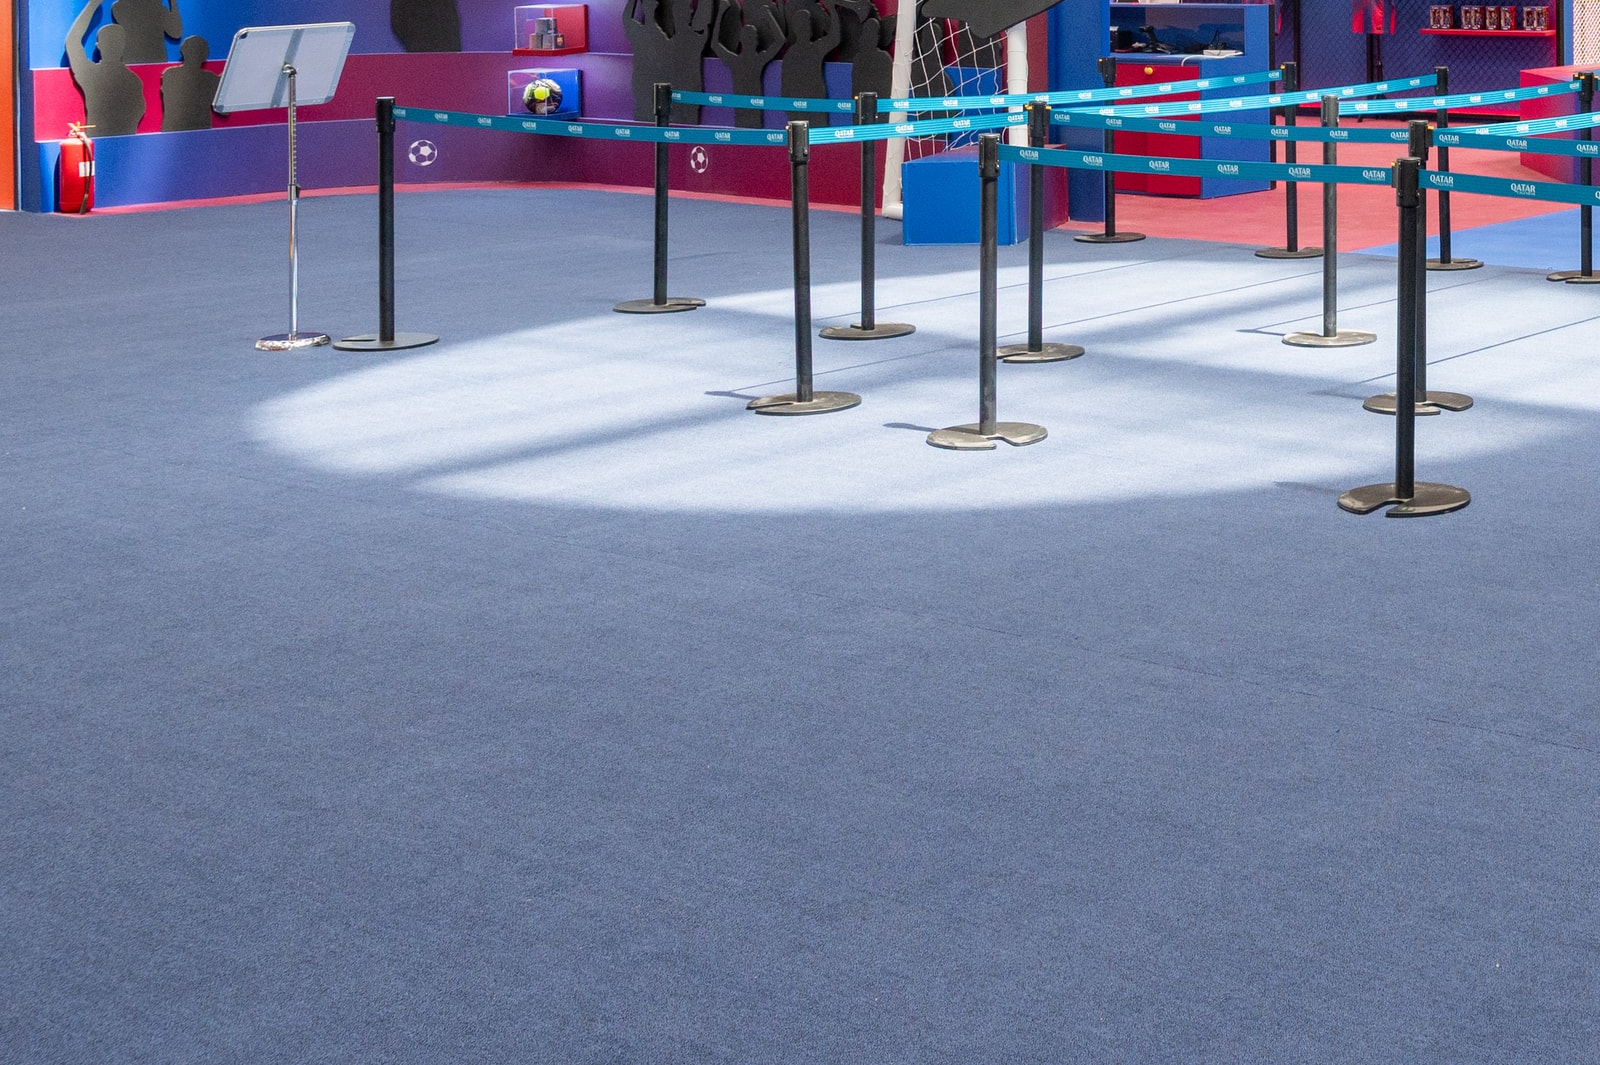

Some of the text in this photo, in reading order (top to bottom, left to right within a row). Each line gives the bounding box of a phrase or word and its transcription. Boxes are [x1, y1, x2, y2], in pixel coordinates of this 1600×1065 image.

[1330, 130, 1348, 138] QATAR
[1507, 140, 1527, 148] QATAR
[1577, 144, 1598, 153] QATAR
[1020, 150, 1038, 158] QATAR
[1083, 155, 1103, 164] QATAR
[1149, 160, 1169, 169] QATAR
[1218, 164, 1238, 173] QATAR
[1288, 167, 1310, 176] QATAR
[1363, 170, 1385, 179] QATAR
[1430, 175, 1454, 184] QATAR
[1510, 184, 1536, 192] QATAR
